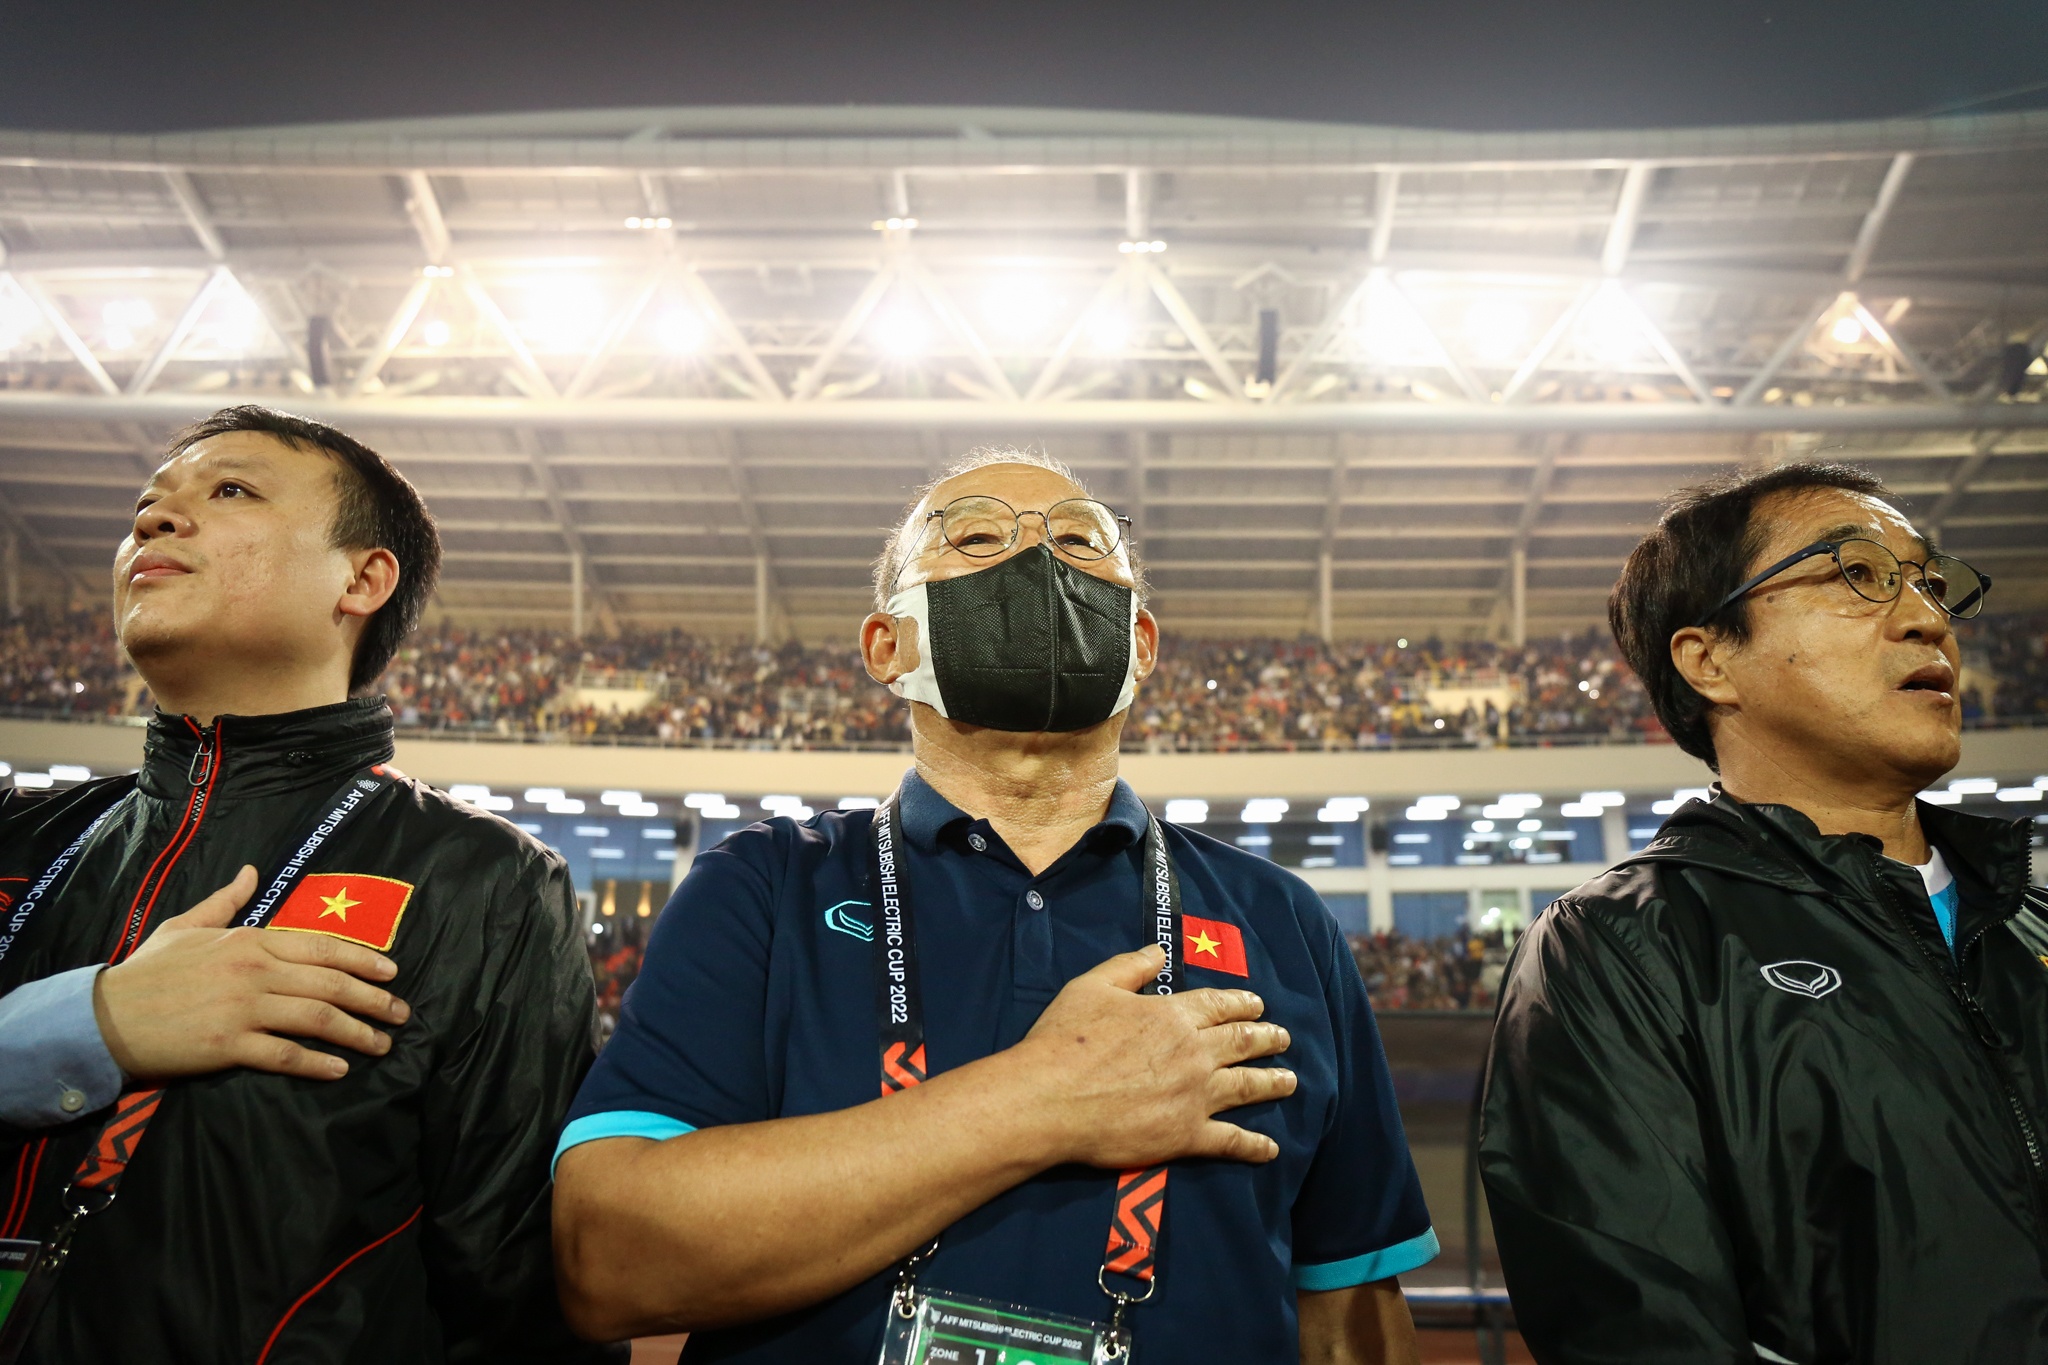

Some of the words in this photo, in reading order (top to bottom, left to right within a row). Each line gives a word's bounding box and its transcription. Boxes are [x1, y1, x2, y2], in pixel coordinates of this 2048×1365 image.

[341, 789, 364, 810] AFF
[291, 808, 348, 866] MITSUBISHI
[878, 823, 896, 883] MITSUBISHI
[27, 846, 80, 900] ELECTRIC
[1156, 848, 1171, 915] MITSUBISHI
[9, 902, 35, 932] CUP
[243, 866, 299, 927] ELECTRIC
[882, 884, 903, 946] ELECTRIC
[887, 949, 905, 982] CUP
[890, 985, 908, 1024] 2022
[929, 1346, 959, 1361] ZONE
[941, 1315, 959, 1326] AFF
[958, 1317, 1004, 1335] MITSUBISHI
[1004, 1326, 1043, 1343] ELECTRIC
[1043, 1334, 1062, 1346] CUP
[1062, 1338, 1083, 1351] 2022
